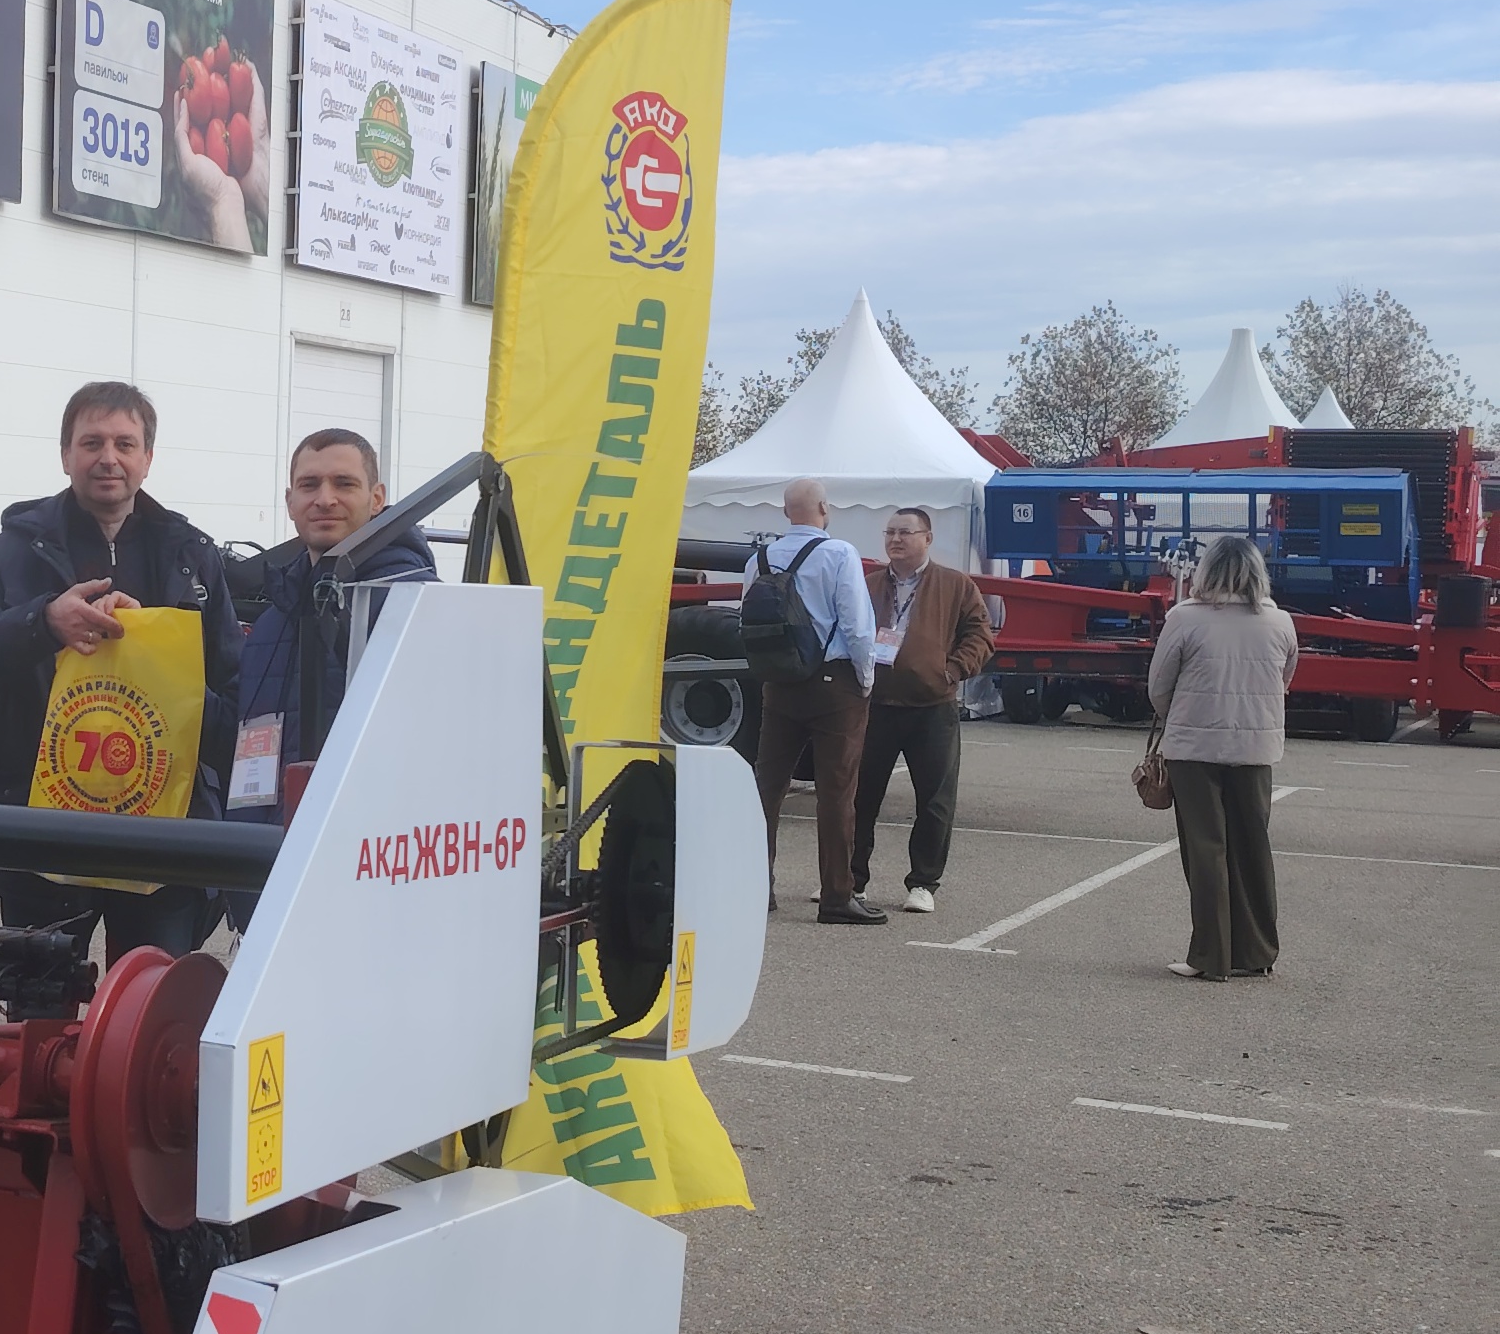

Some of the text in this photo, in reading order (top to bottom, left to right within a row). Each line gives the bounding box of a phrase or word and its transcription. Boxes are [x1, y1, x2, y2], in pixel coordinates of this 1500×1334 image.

[85, 0, 105, 47] D
[84, 60, 128, 85] павильон
[334, 60, 367, 83] АКСАКАЛ
[323, 97, 357, 116] СУПЕРСТАР
[623, 99, 677, 135] АКД
[82, 106, 150, 167] 3013
[81, 164, 110, 188] стенд
[1016, 507, 1029, 518] 16
[46, 680, 163, 738] АКСАЙКАРДАНДЕТАЛЬ
[63, 694, 118, 718] КАРДАННЫЕ
[123, 701, 146, 727] ВАЛЫ
[74, 731, 136, 776] 70
[48, 784, 75, 810] ИСТО
[356, 816, 527, 886] АКДЖВН-6Р
[251, 1167, 277, 1193] STOP
